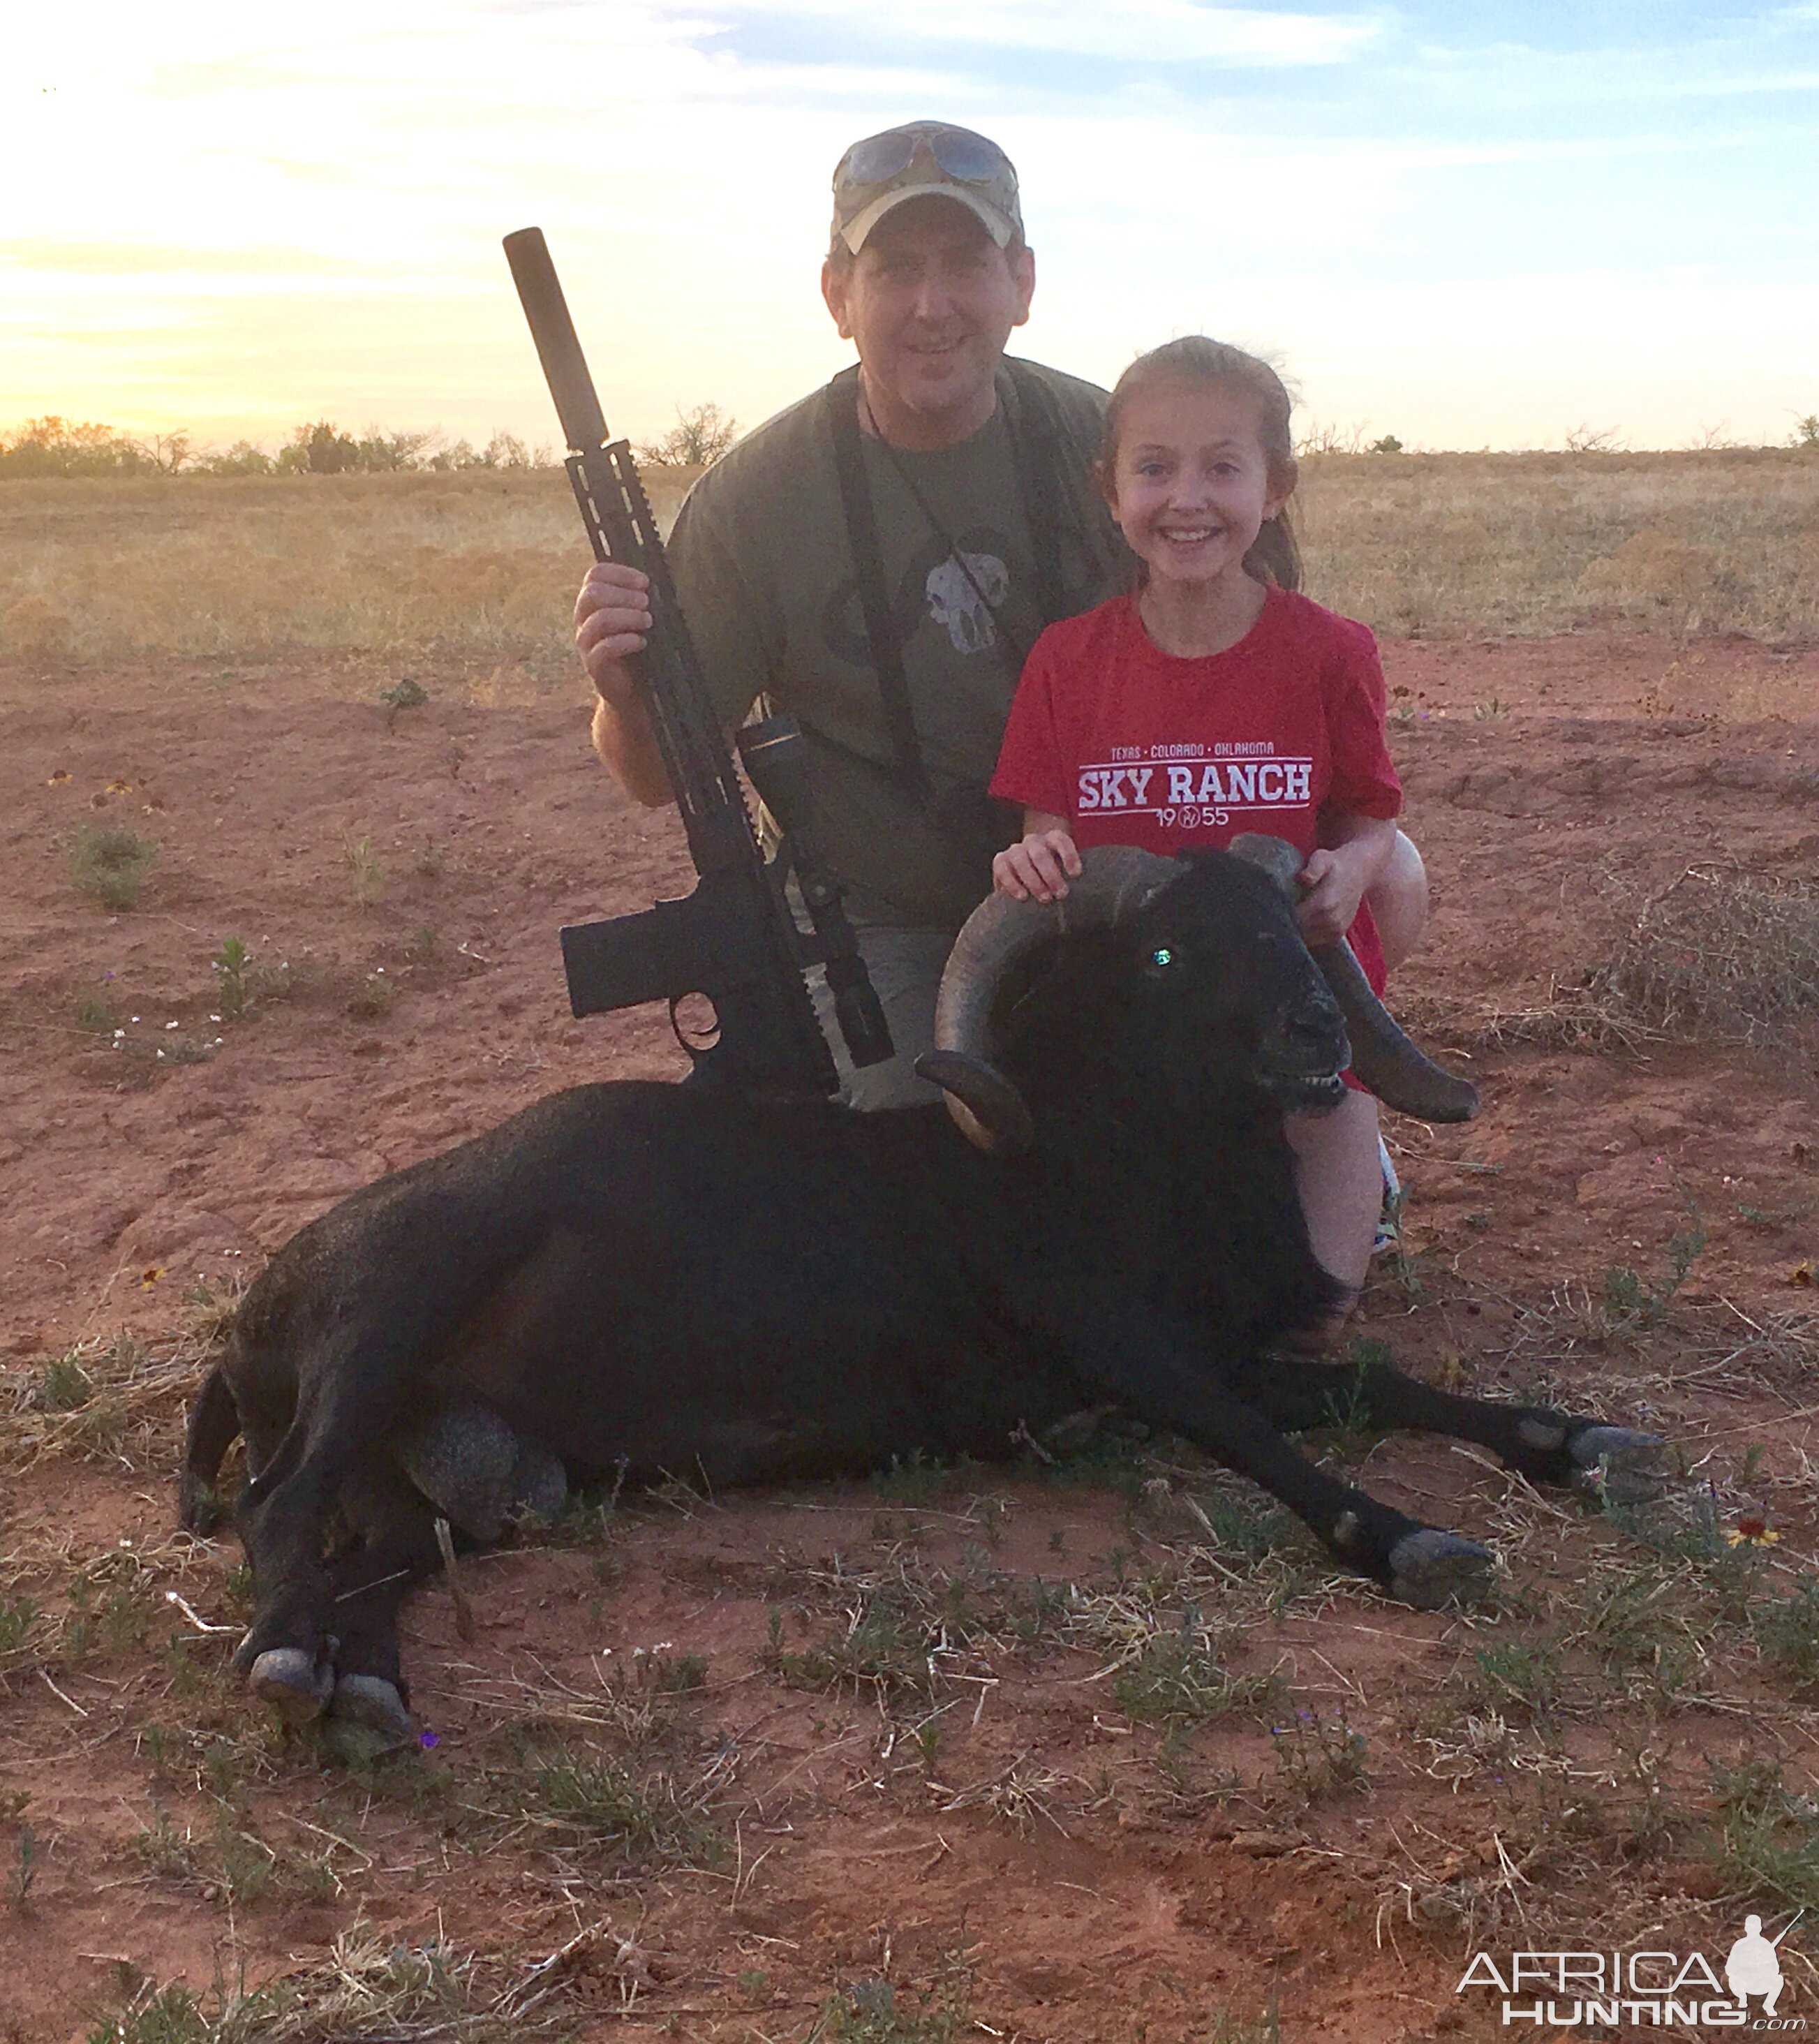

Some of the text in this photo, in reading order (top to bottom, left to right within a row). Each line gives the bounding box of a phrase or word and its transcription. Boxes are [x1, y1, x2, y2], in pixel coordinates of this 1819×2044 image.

[1111, 741, 1275, 761] TEXAS COLORADO OKLAHOMA
[1079, 764, 1312, 808] SKY RANCH
